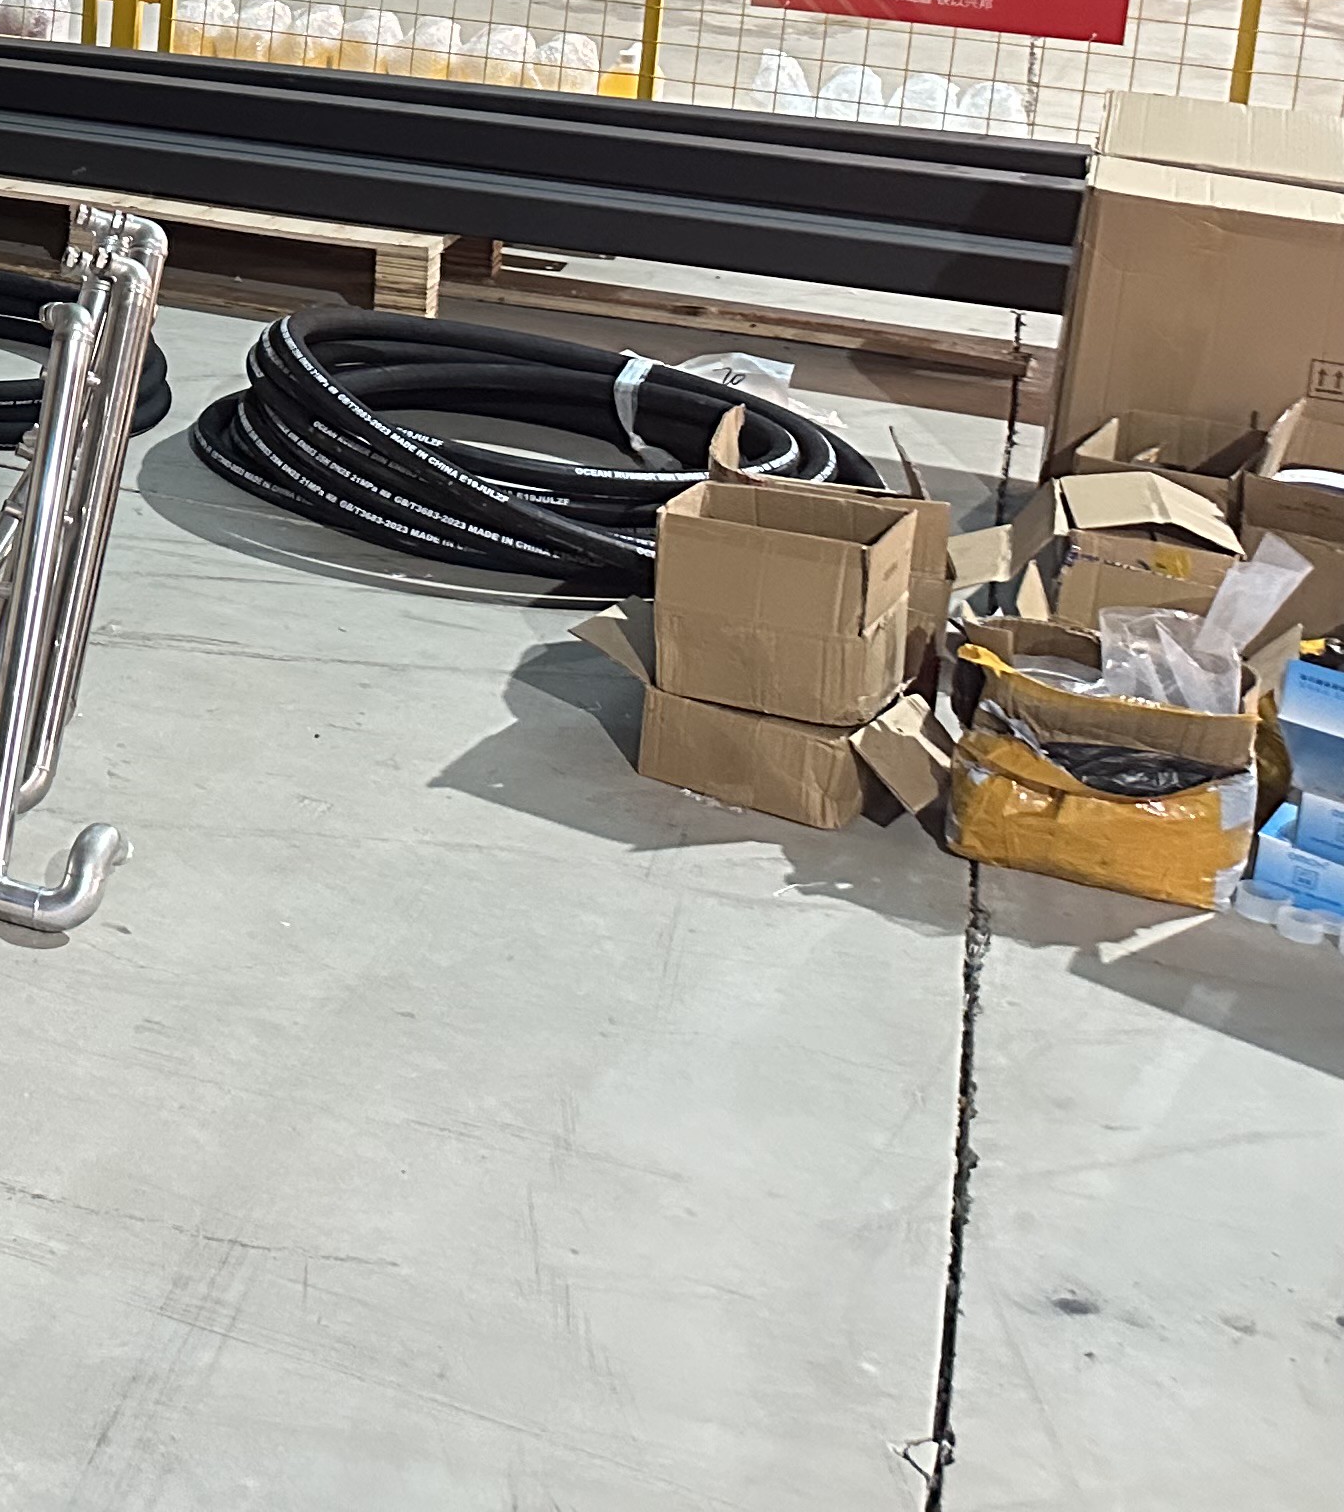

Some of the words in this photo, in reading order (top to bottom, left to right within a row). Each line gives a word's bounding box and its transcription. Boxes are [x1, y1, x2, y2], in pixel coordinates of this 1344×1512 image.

[313, 420, 338, 439] OCEAN
[390, 432, 416, 453] MADE
[416, 448, 428, 461] IN
[427, 456, 458, 479] CHINA
[574, 467, 613, 478] OCEAN
[339, 499, 408, 534] GB/T3683-2023
[410, 528, 440, 545] MADE
[350, 470, 379, 493] 21MPa
[394, 496, 467, 530] GB/T3683-2023
[468, 524, 500, 542] MADE
[501, 536, 515, 546] IN
